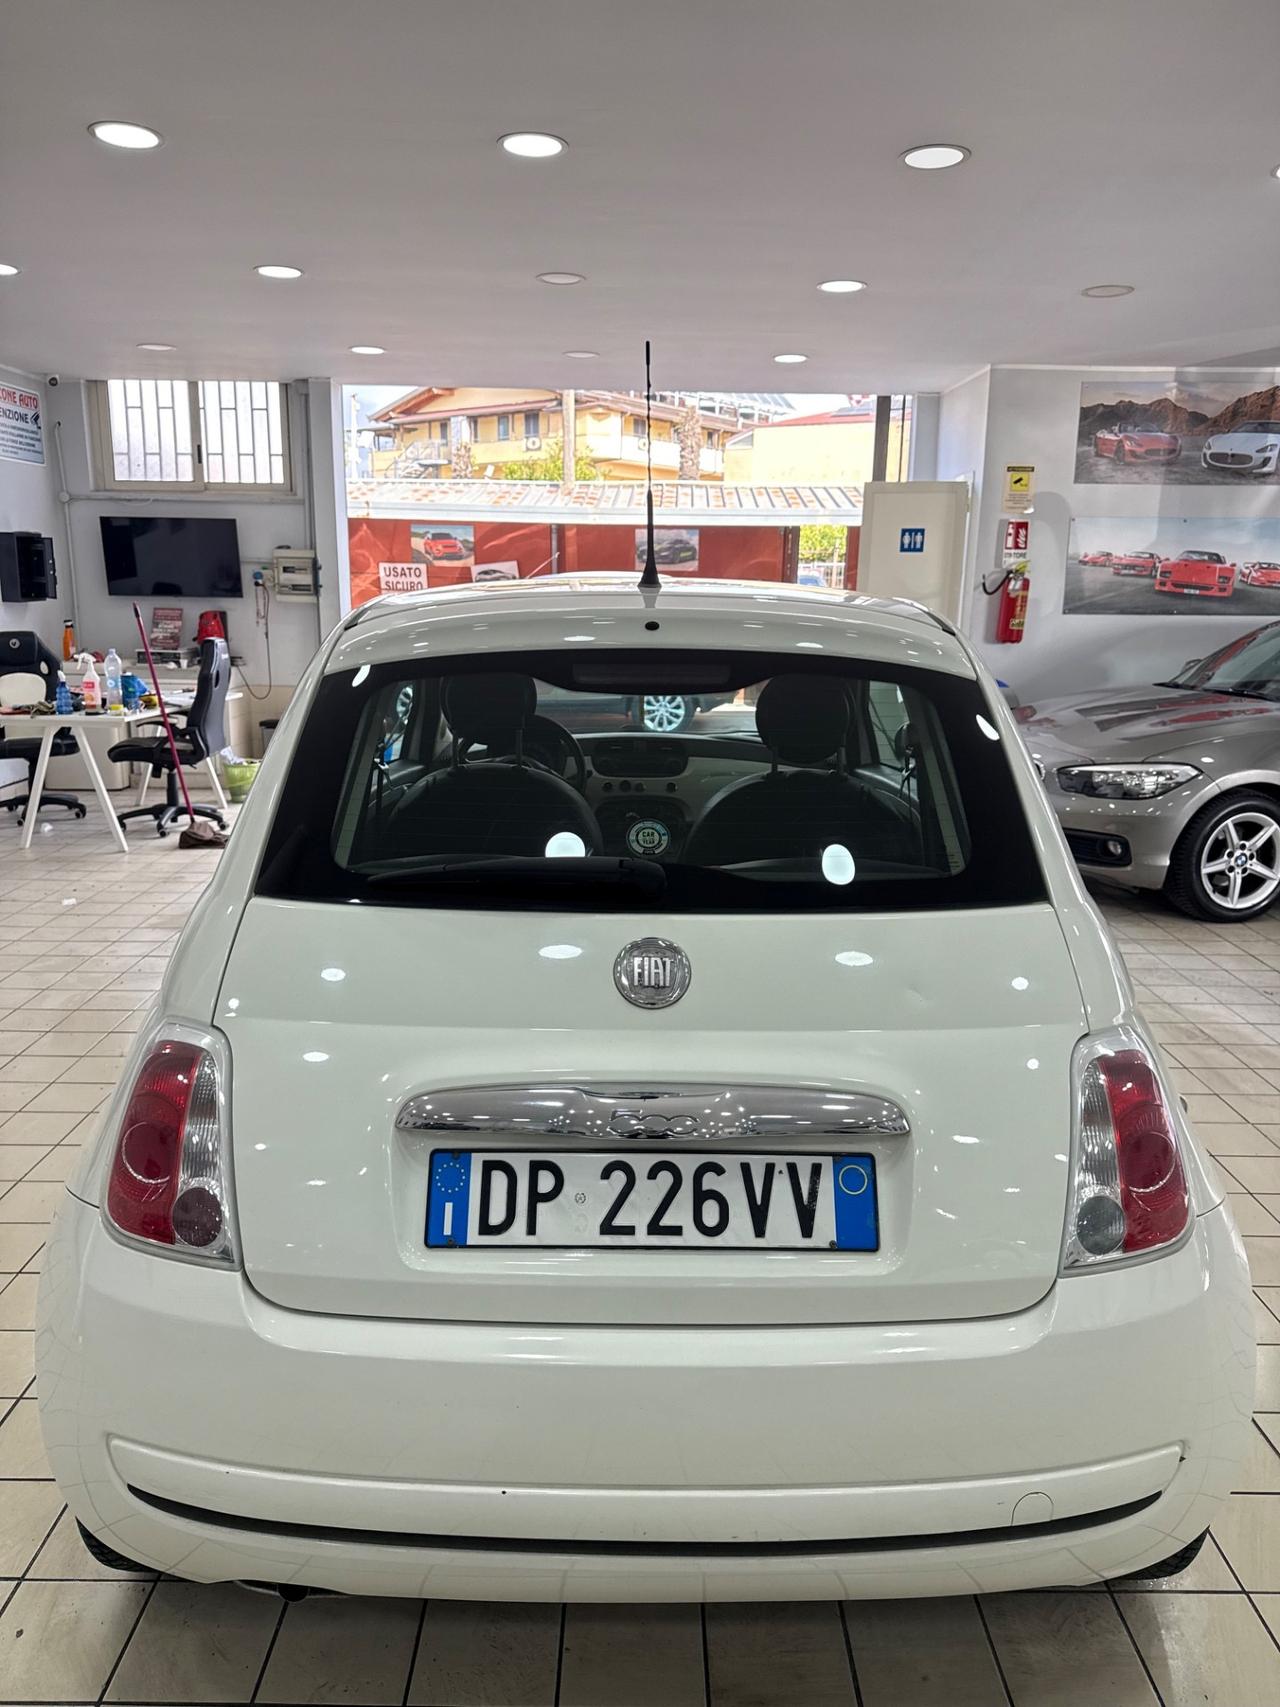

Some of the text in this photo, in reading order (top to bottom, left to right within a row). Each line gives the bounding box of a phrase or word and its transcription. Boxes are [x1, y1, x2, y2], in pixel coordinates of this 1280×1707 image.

[0, 388, 38, 409] ONE AUTO
[383, 566, 422, 578] USATO
[385, 580, 423, 591] SICURO
[633, 957, 671, 987] FIAT
[607, 1109, 699, 1137] 500
[478, 1160, 823, 1238] DP 226VV
